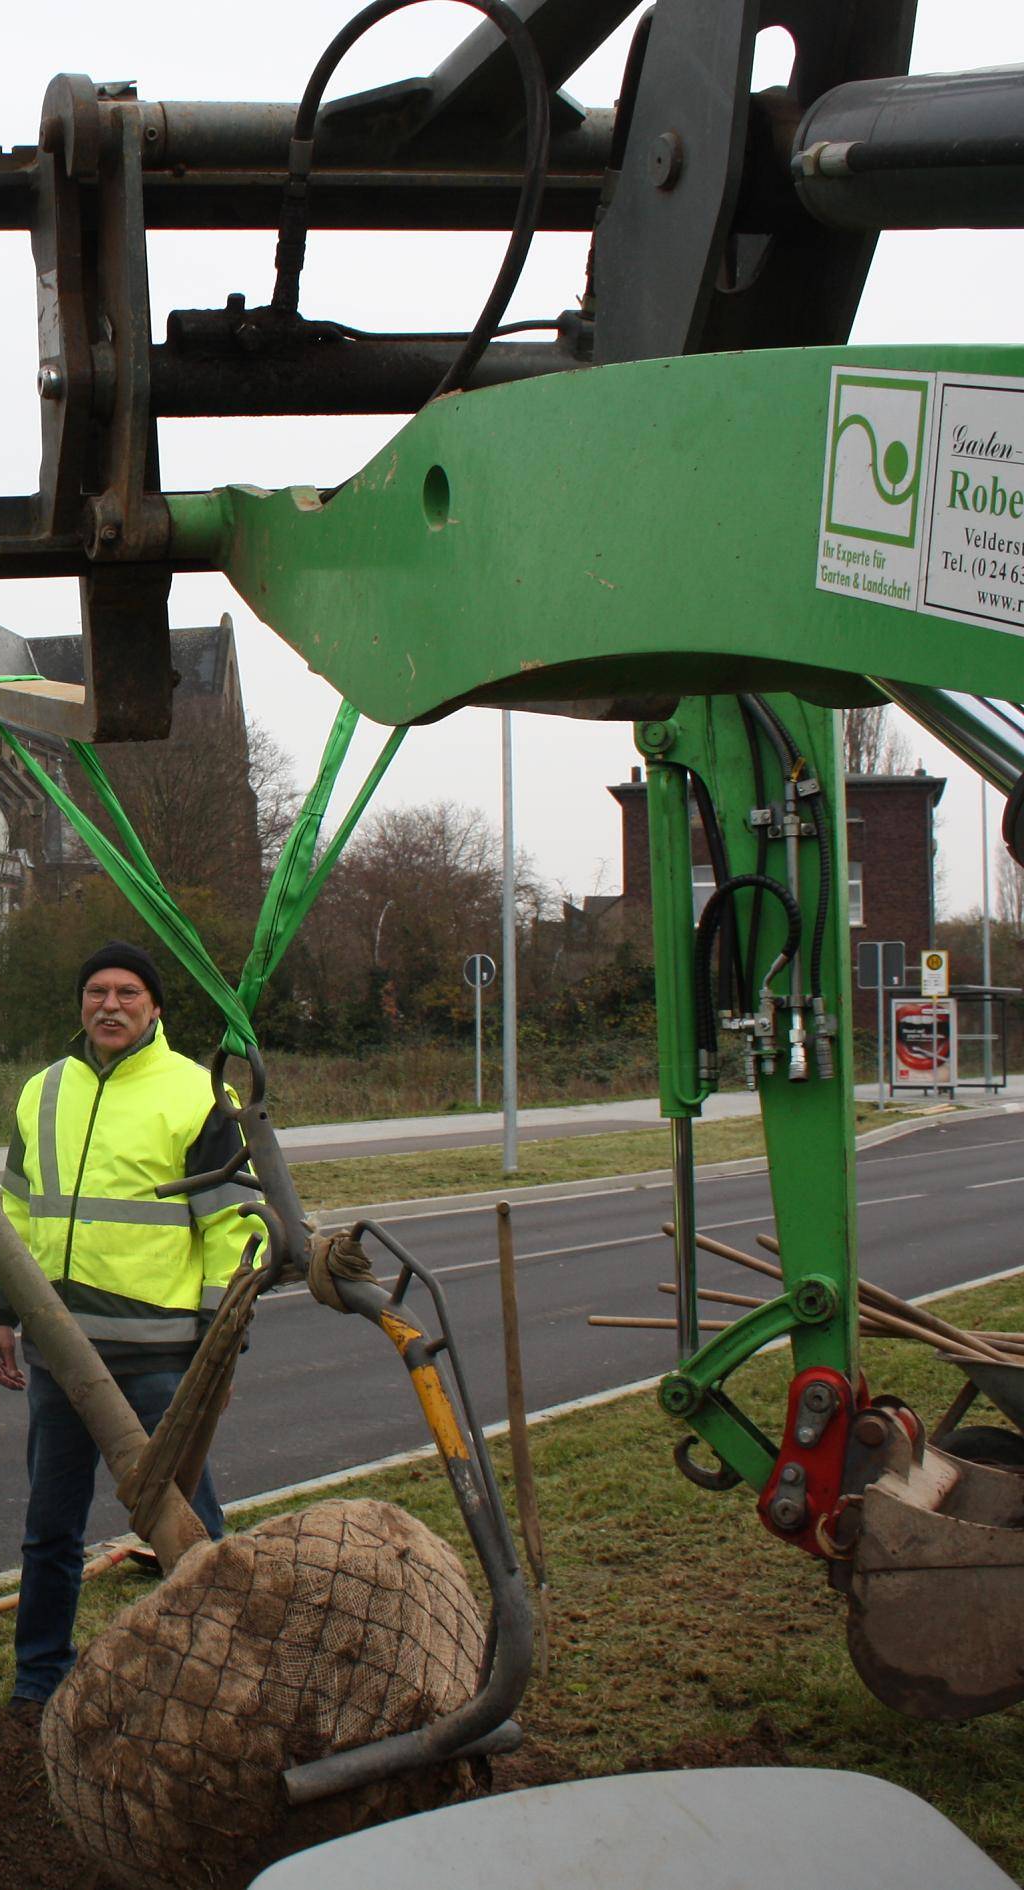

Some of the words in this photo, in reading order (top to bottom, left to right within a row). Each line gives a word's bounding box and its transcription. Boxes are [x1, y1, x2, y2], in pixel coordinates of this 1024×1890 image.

[946, 470, 1024, 519] Robe
[822, 540, 835, 558] Ihr
[836, 543, 870, 567] Experte
[873, 549, 886, 569] für
[942, 551, 967, 573] Tel.
[820, 564, 850, 587] Garten
[852, 572, 859, 590] &
[862, 573, 911, 600] Landschaft
